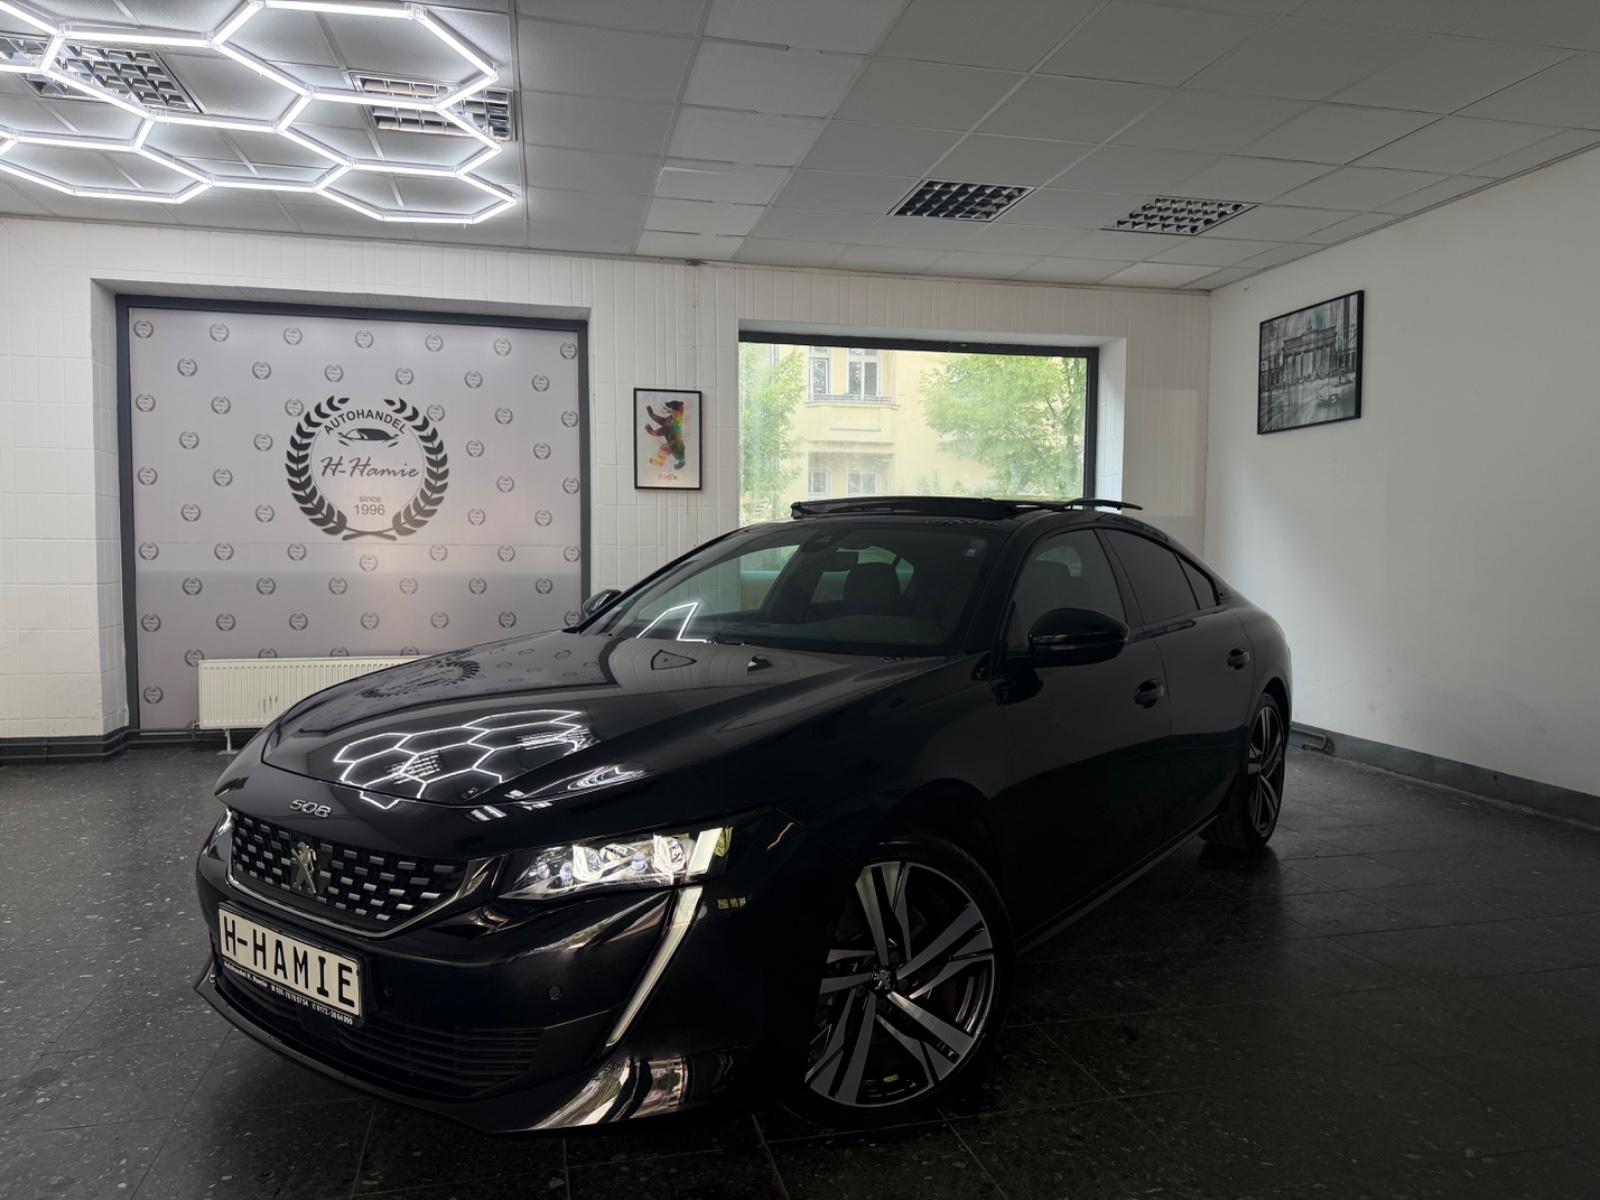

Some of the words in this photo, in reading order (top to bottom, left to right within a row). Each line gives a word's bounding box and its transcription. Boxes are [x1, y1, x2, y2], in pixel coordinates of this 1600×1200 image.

[323, 409, 408, 435] AUTOHANDEL
[320, 456, 420, 478] H-Hamie
[359, 495, 382, 503] since
[354, 504, 385, 516] 1996
[289, 799, 332, 818] 508
[223, 915, 355, 1008] H-HAMIE
